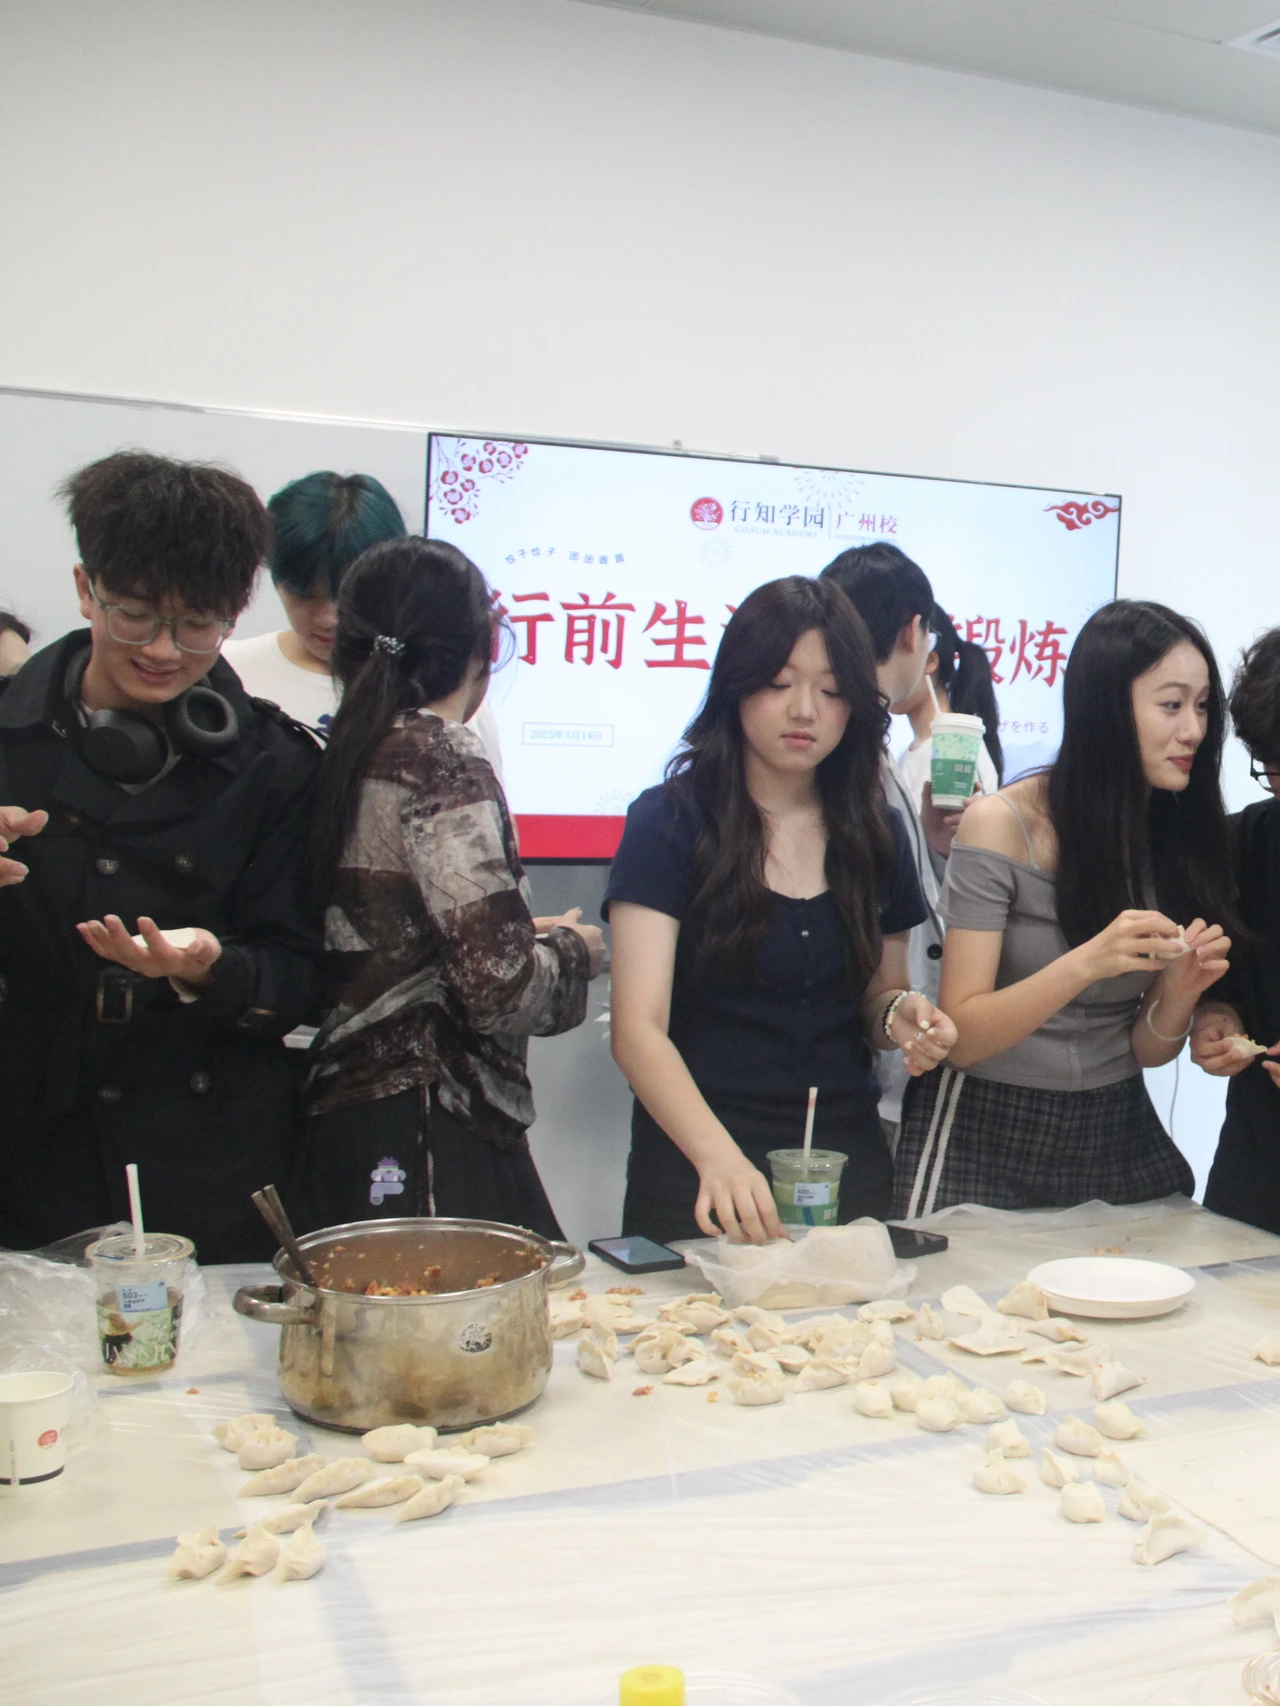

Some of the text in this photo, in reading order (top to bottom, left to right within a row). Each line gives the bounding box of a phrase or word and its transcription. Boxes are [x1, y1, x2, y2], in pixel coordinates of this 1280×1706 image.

[730, 500, 898, 534] 行知学园 广州校
[529, 727, 603, 740] 2025年3月14日
